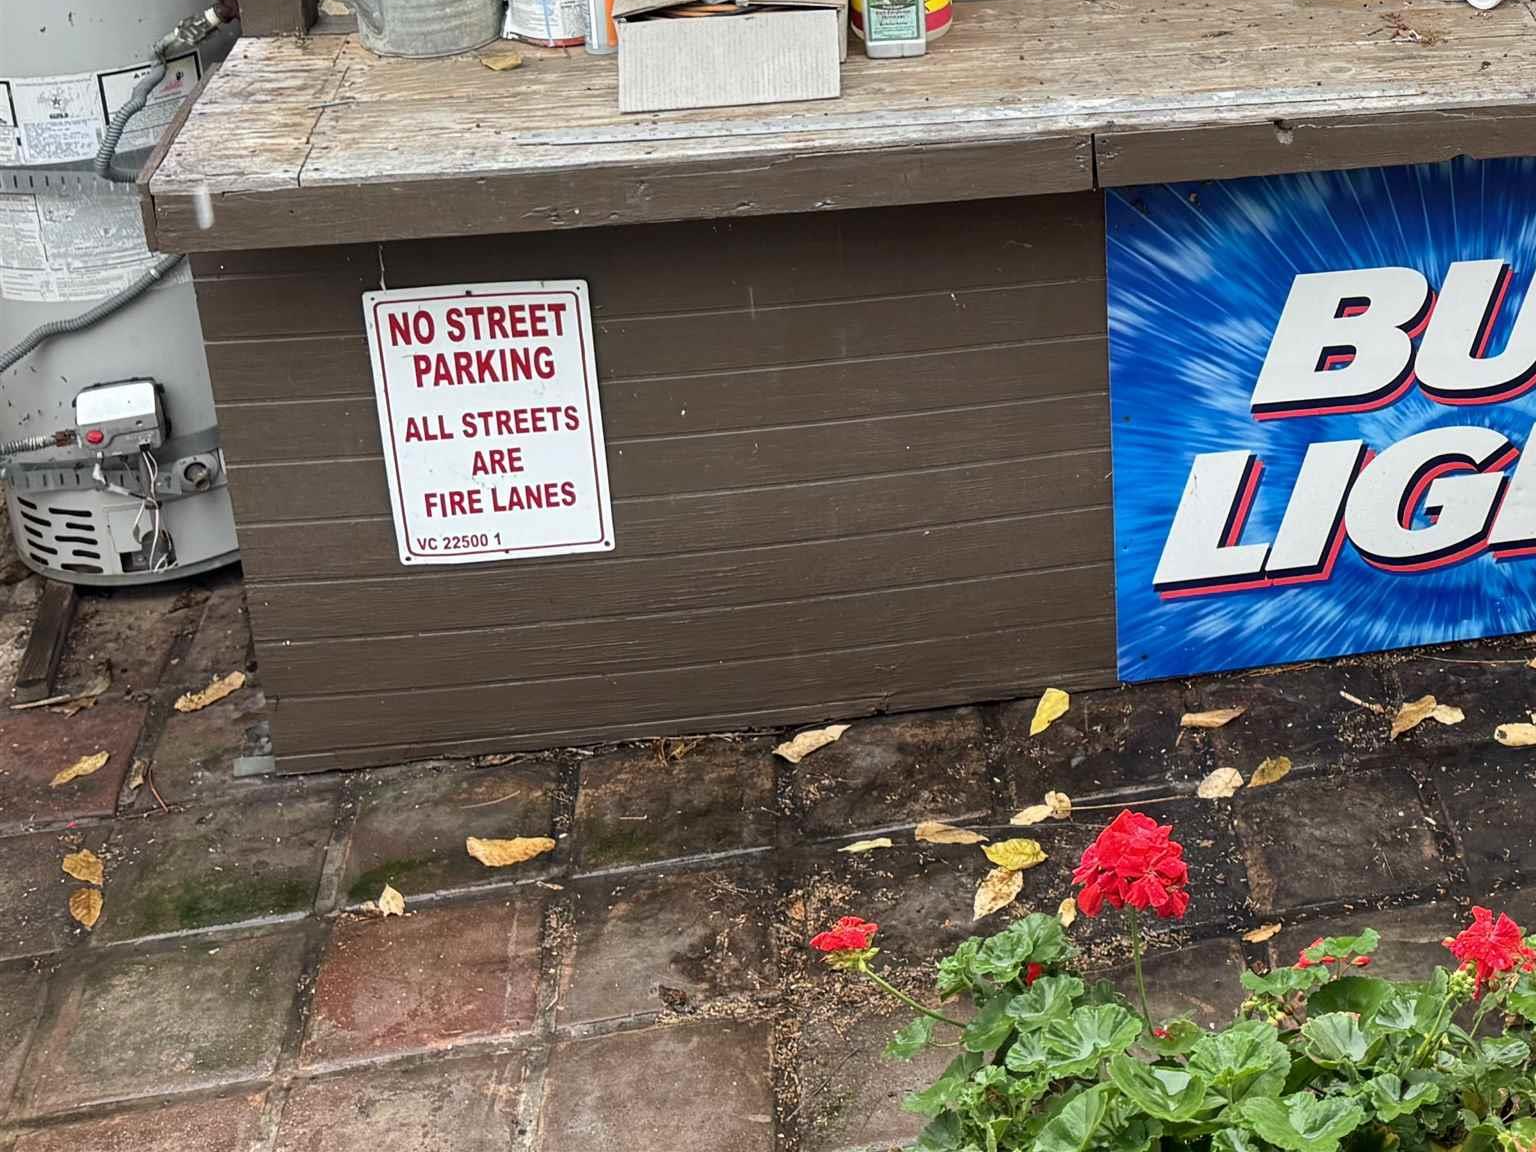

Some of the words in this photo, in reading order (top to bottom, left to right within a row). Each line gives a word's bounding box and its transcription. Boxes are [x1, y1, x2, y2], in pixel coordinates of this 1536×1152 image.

[388, 308, 436, 347] NO
[446, 302, 567, 343] STREET
[412, 345, 556, 388] PARKING
[404, 414, 455, 443] ALL
[462, 405, 580, 438] STREETS
[471, 447, 525, 477] ARE
[423, 488, 485, 519] FIRE
[491, 480, 577, 513] LANES
[416, 537, 439, 552] VC
[442, 533, 489, 550] 22500
